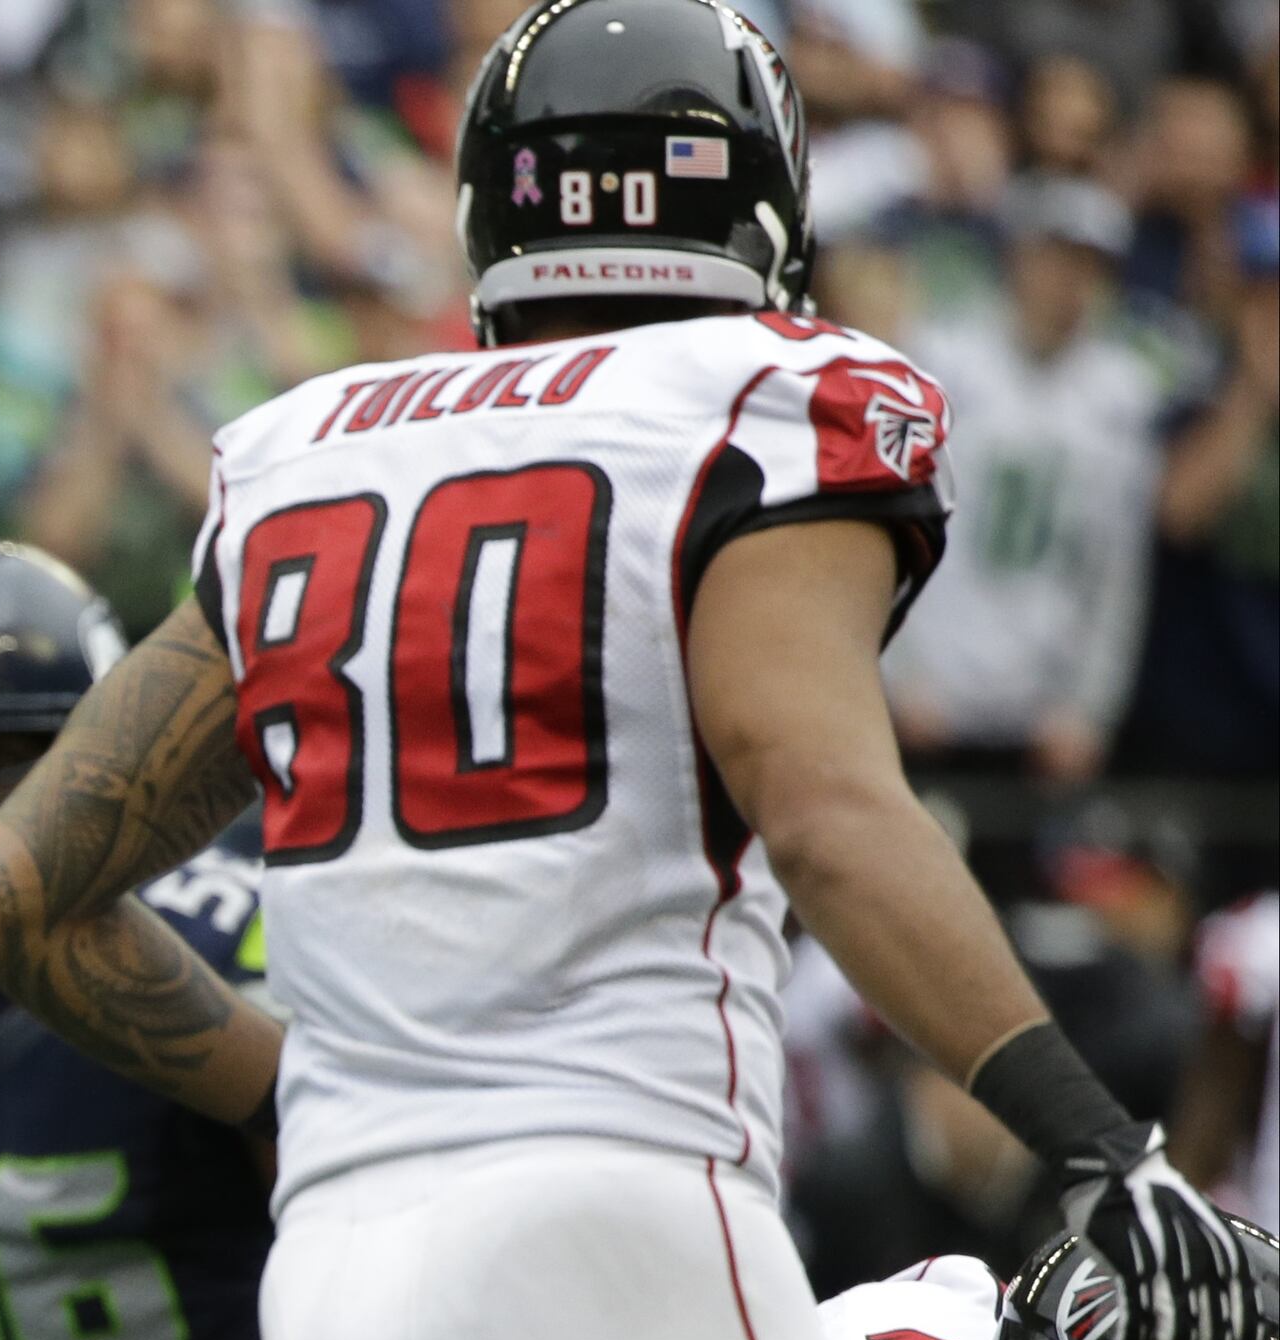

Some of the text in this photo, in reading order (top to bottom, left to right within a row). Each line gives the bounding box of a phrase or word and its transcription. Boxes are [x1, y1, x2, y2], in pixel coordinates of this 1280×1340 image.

[559, 170, 657, 226] 80
[532, 263, 695, 283] FALCONS
[310, 346, 617, 443] TUILOLO
[234, 460, 612, 867] 80
